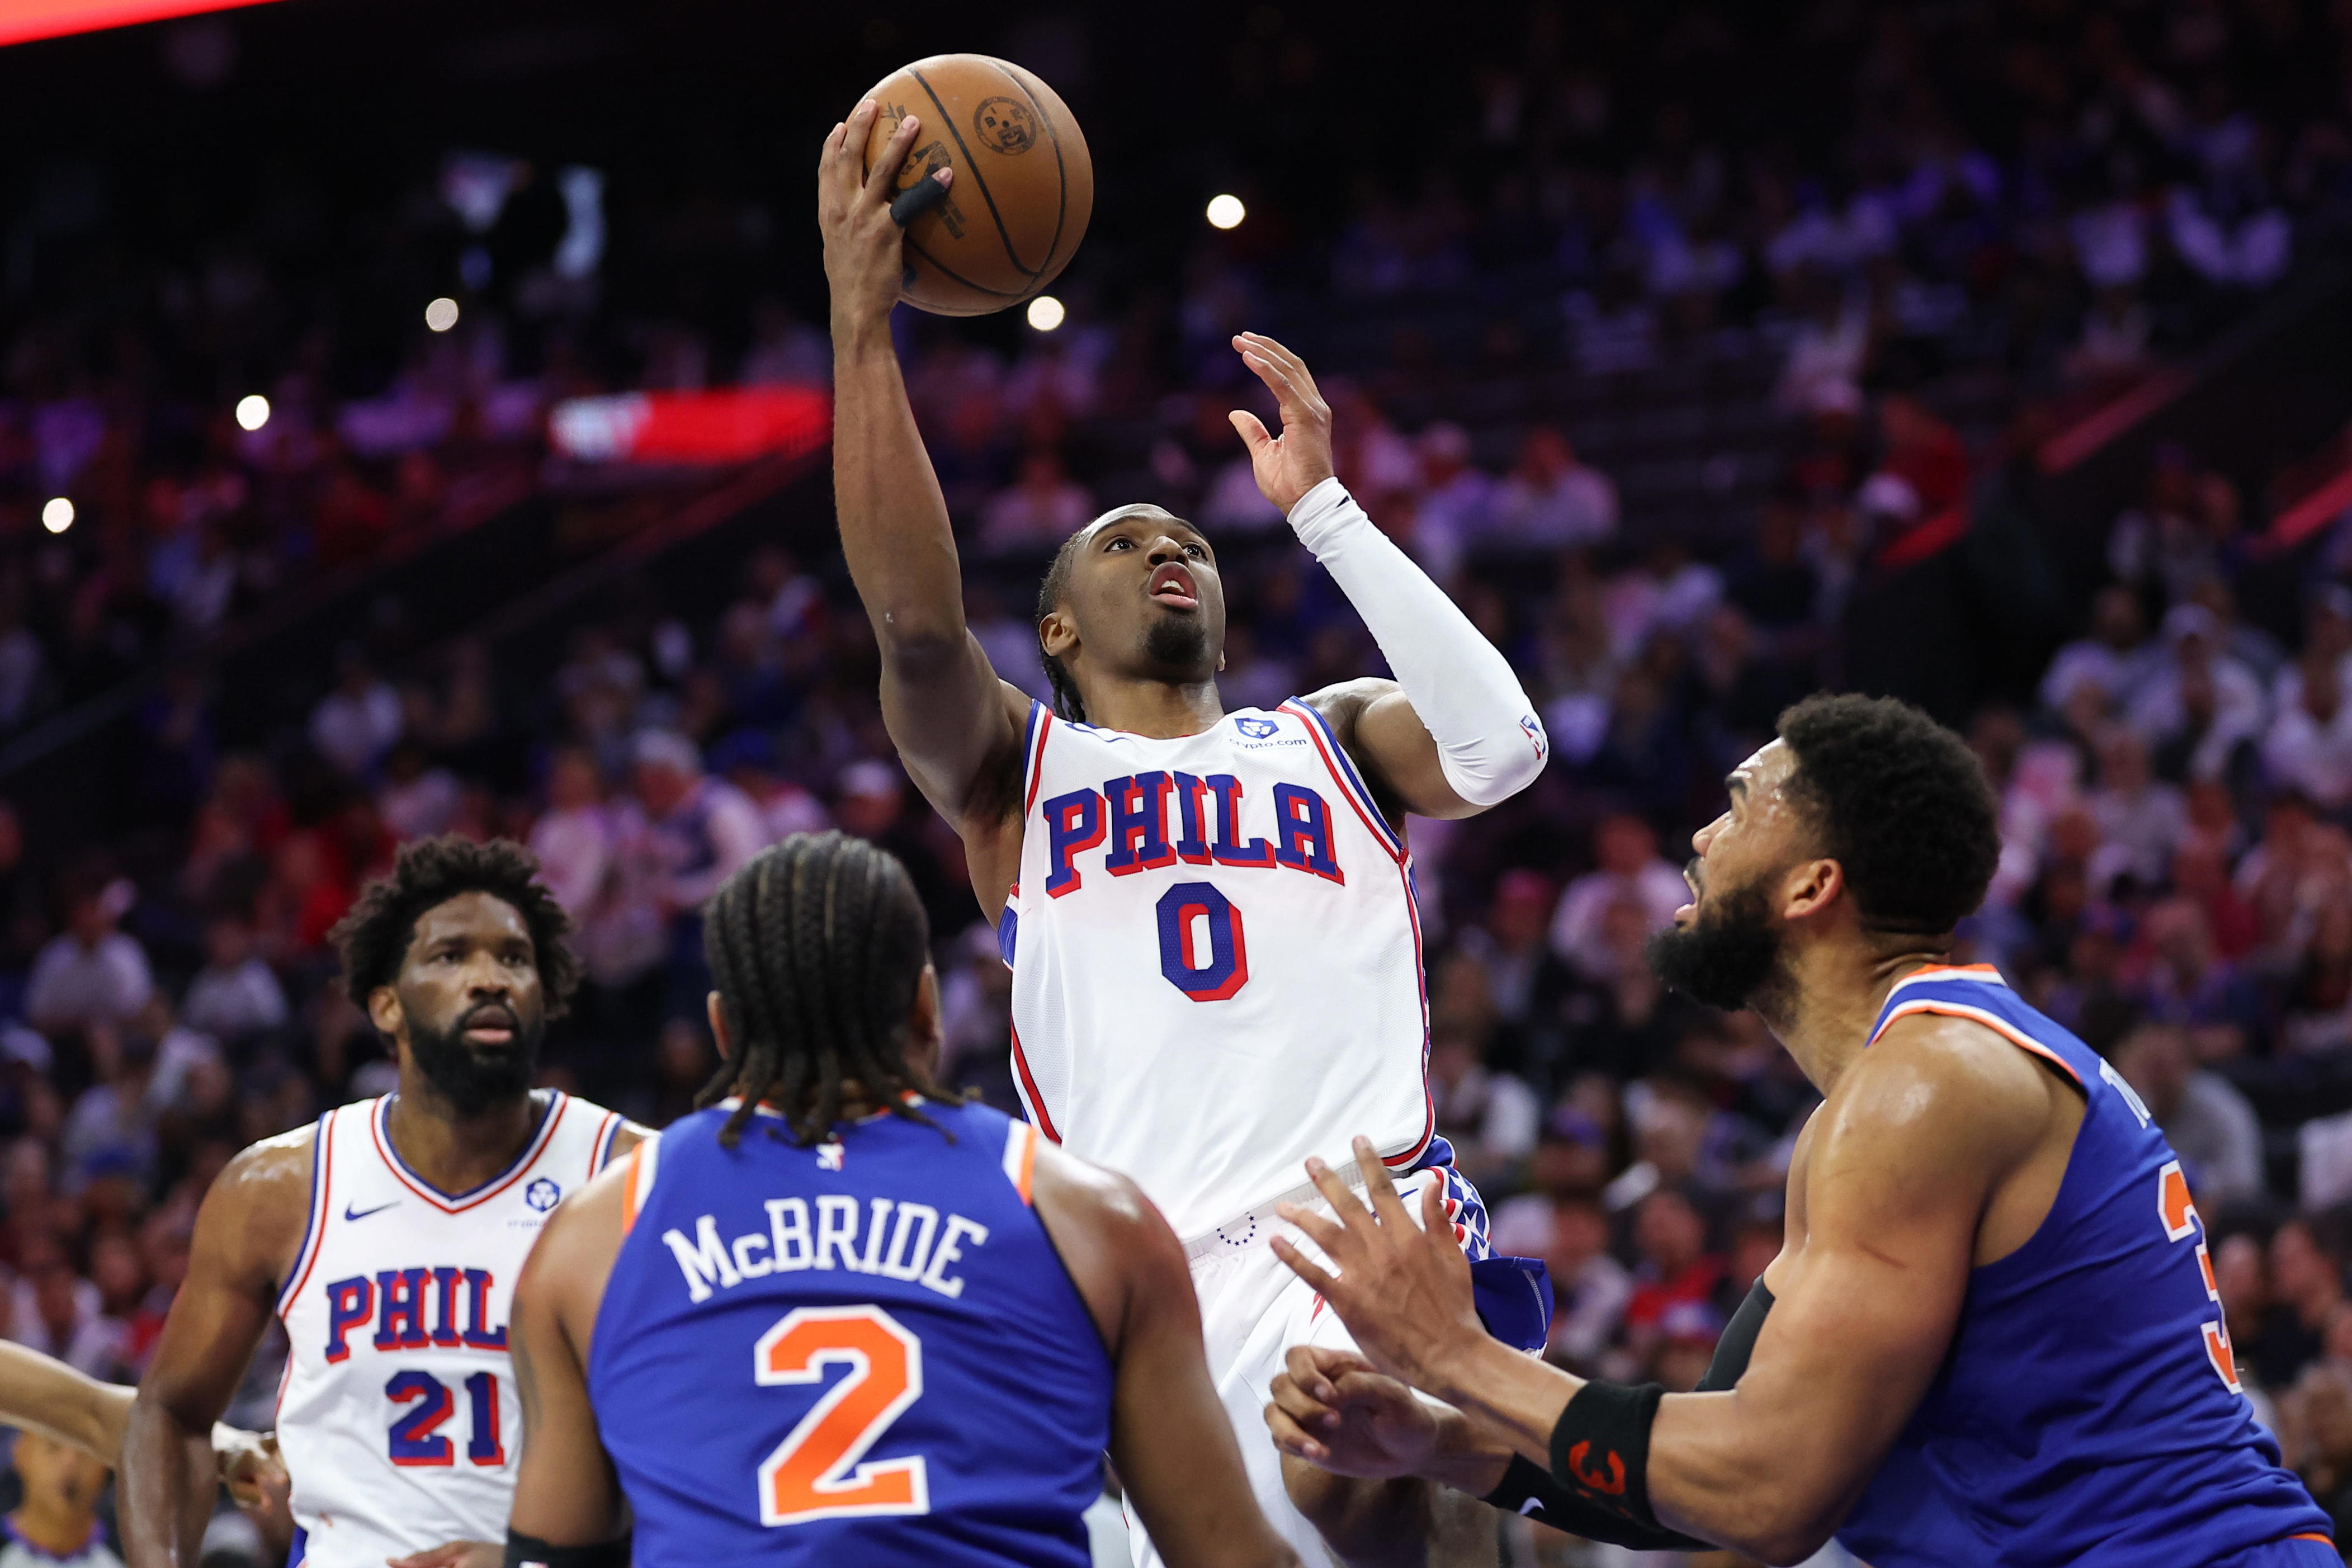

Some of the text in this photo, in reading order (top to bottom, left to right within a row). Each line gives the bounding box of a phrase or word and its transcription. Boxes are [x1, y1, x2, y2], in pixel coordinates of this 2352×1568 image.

[1229, 738, 1307, 749] crypto.com
[1043, 770, 1345, 899] PHILA
[1156, 882, 1249, 1002] 0
[662, 1194, 989, 1304] McBRIDE
[385, 1369, 505, 1466] 21
[754, 1303, 931, 1528] 2
[1569, 1439, 1632, 1518] 3
